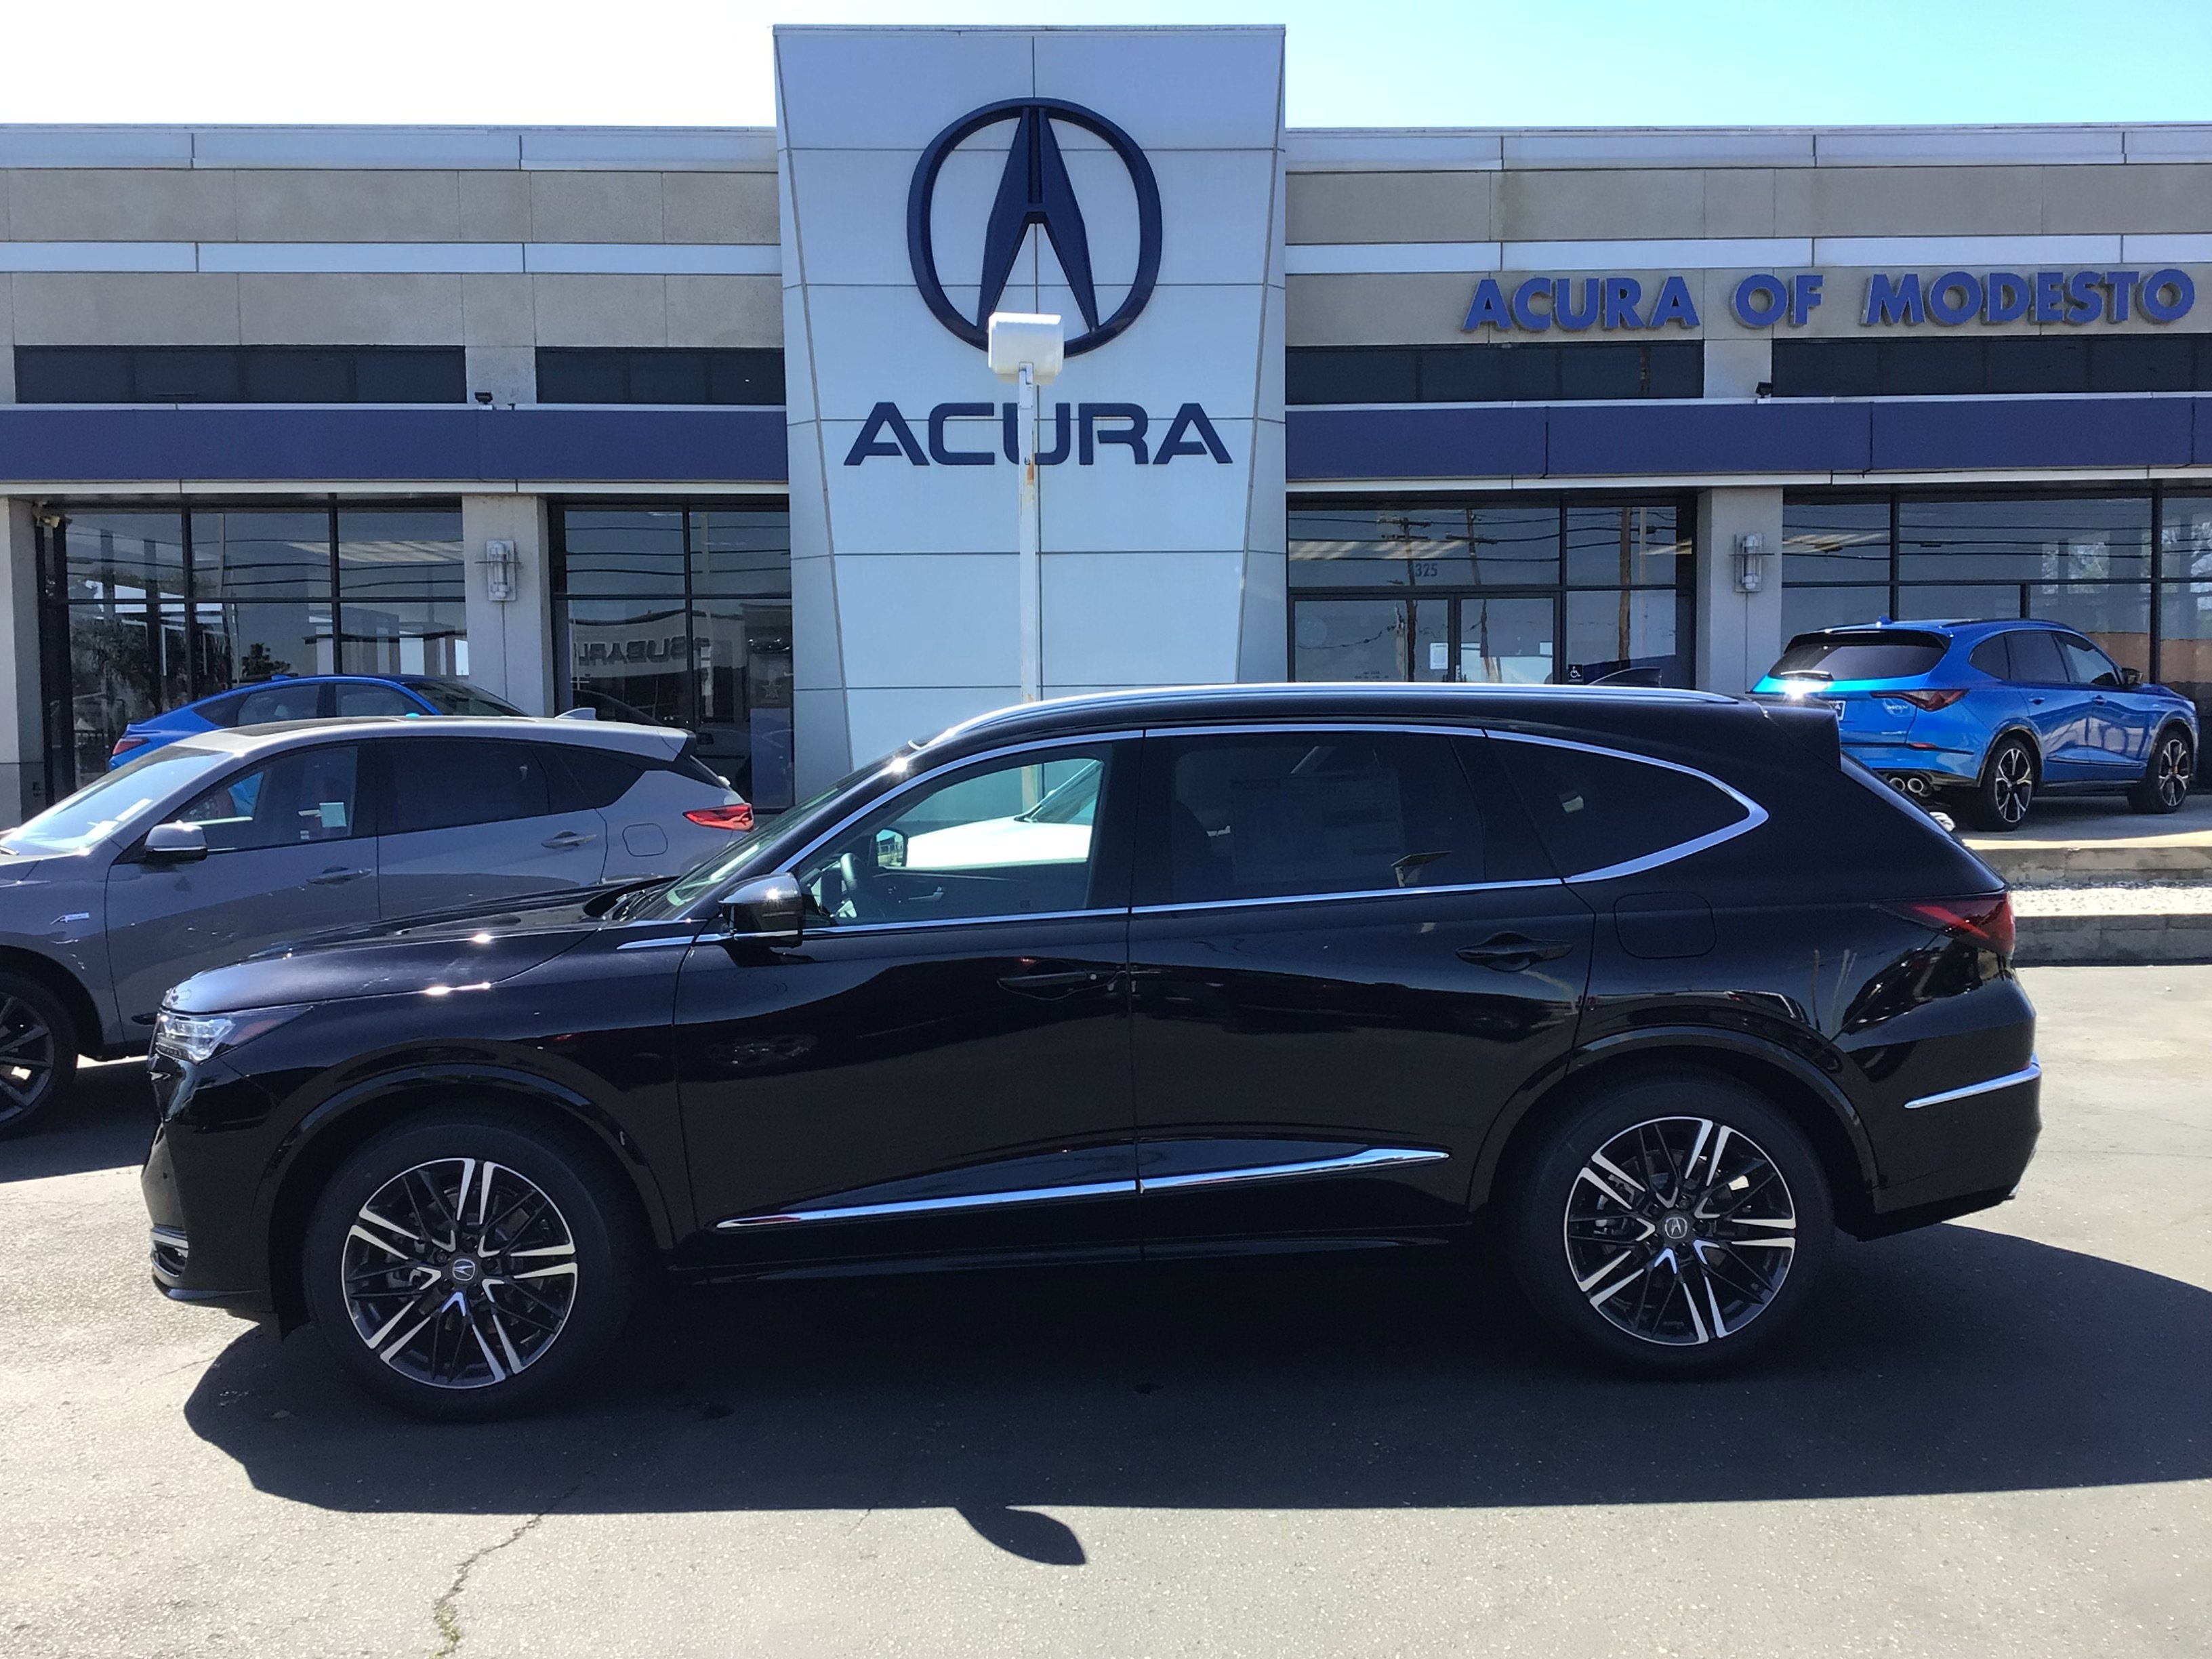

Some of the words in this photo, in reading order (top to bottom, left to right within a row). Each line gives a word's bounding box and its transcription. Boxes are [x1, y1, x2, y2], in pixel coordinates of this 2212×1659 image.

[1462, 275, 1700, 332] ACURA
[1731, 274, 1824, 329] OF
[1860, 268, 2196, 325] MODESTO
[843, 402, 1233, 466] ACURA
[1414, 562, 1438, 577] 325
